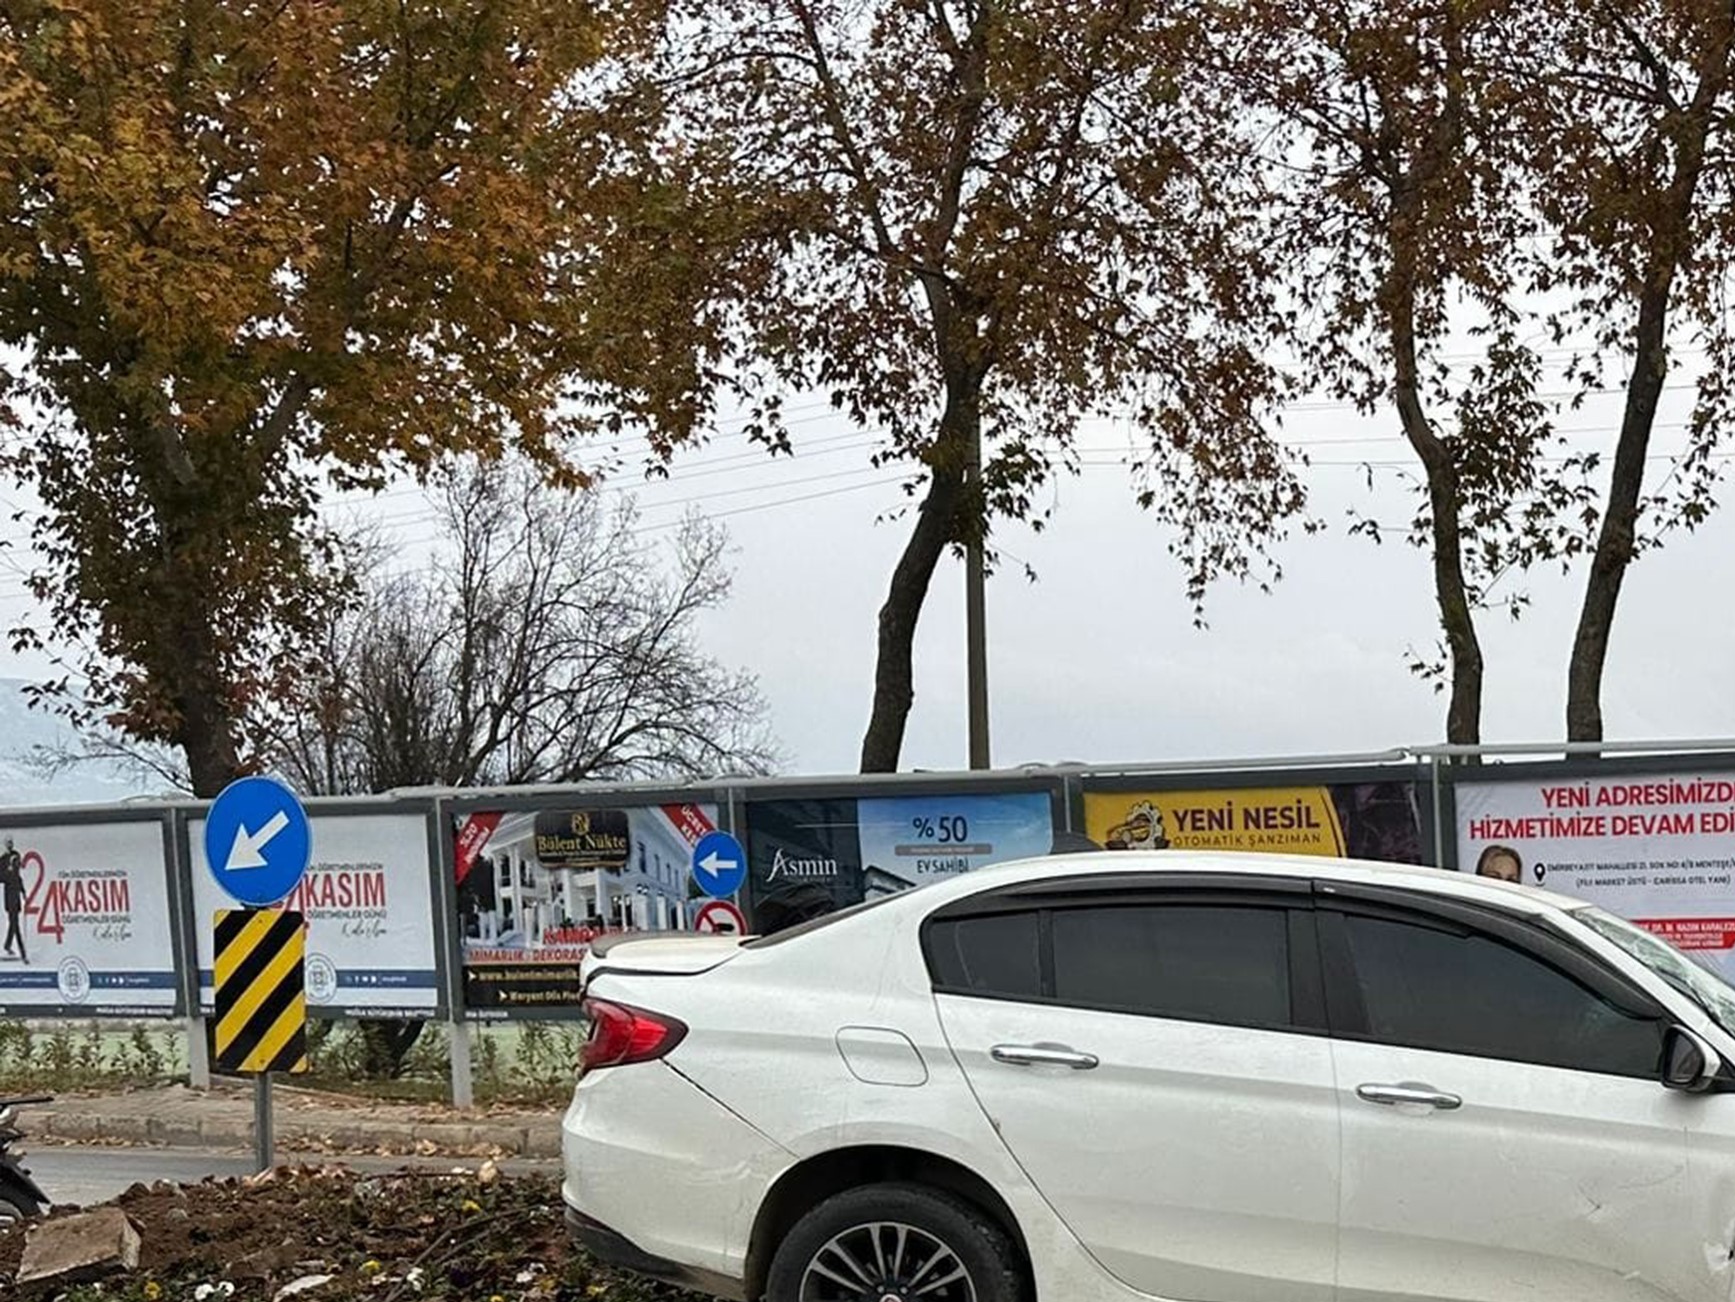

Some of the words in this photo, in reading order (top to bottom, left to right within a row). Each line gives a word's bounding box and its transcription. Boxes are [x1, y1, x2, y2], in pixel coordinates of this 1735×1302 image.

[1541, 781, 1590, 808] YENİ
[1173, 801, 1233, 831] YENİ
[1243, 798, 1320, 830] NESİL
[1470, 811, 1606, 840] HİZMETİMİZE
[1612, 813, 1693, 836] DEVAM
[537, 836, 582, 851] Bülent
[585, 834, 626, 850] Nükte
[1174, 834, 1243, 847] OTOMATİK
[1249, 832, 1321, 847] ŞANZIMAN
[766, 848, 838, 882] Asmin
[916, 859, 931, 874] EV
[60, 879, 131, 914] KASIM
[304, 872, 386, 907] KASIM
[532, 948, 586, 961] DEKORAS
